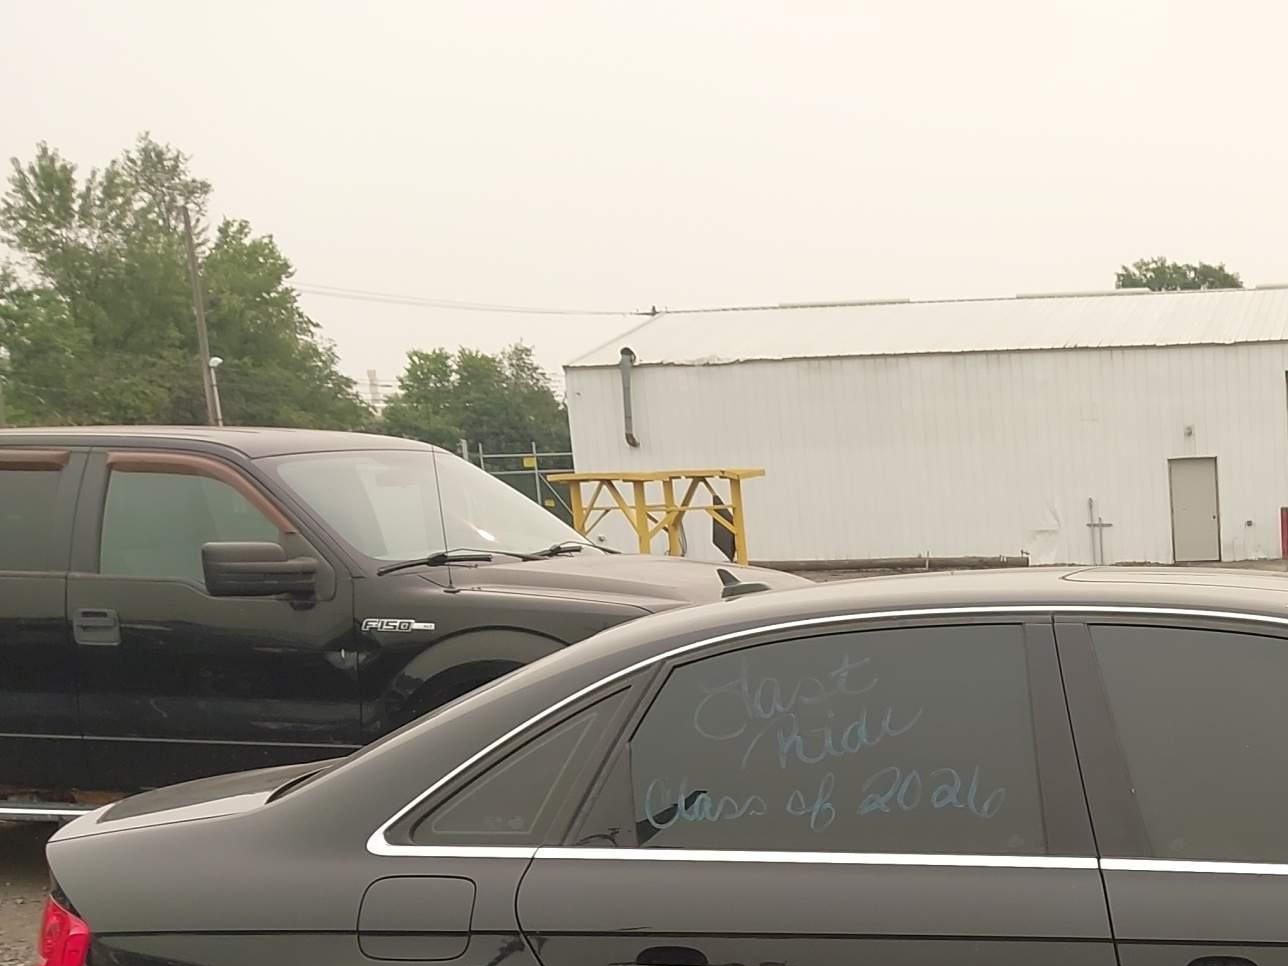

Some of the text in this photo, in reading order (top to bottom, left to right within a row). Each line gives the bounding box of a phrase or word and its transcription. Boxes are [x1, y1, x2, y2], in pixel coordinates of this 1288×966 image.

[645, 765, 1006, 832] Class of 2026
